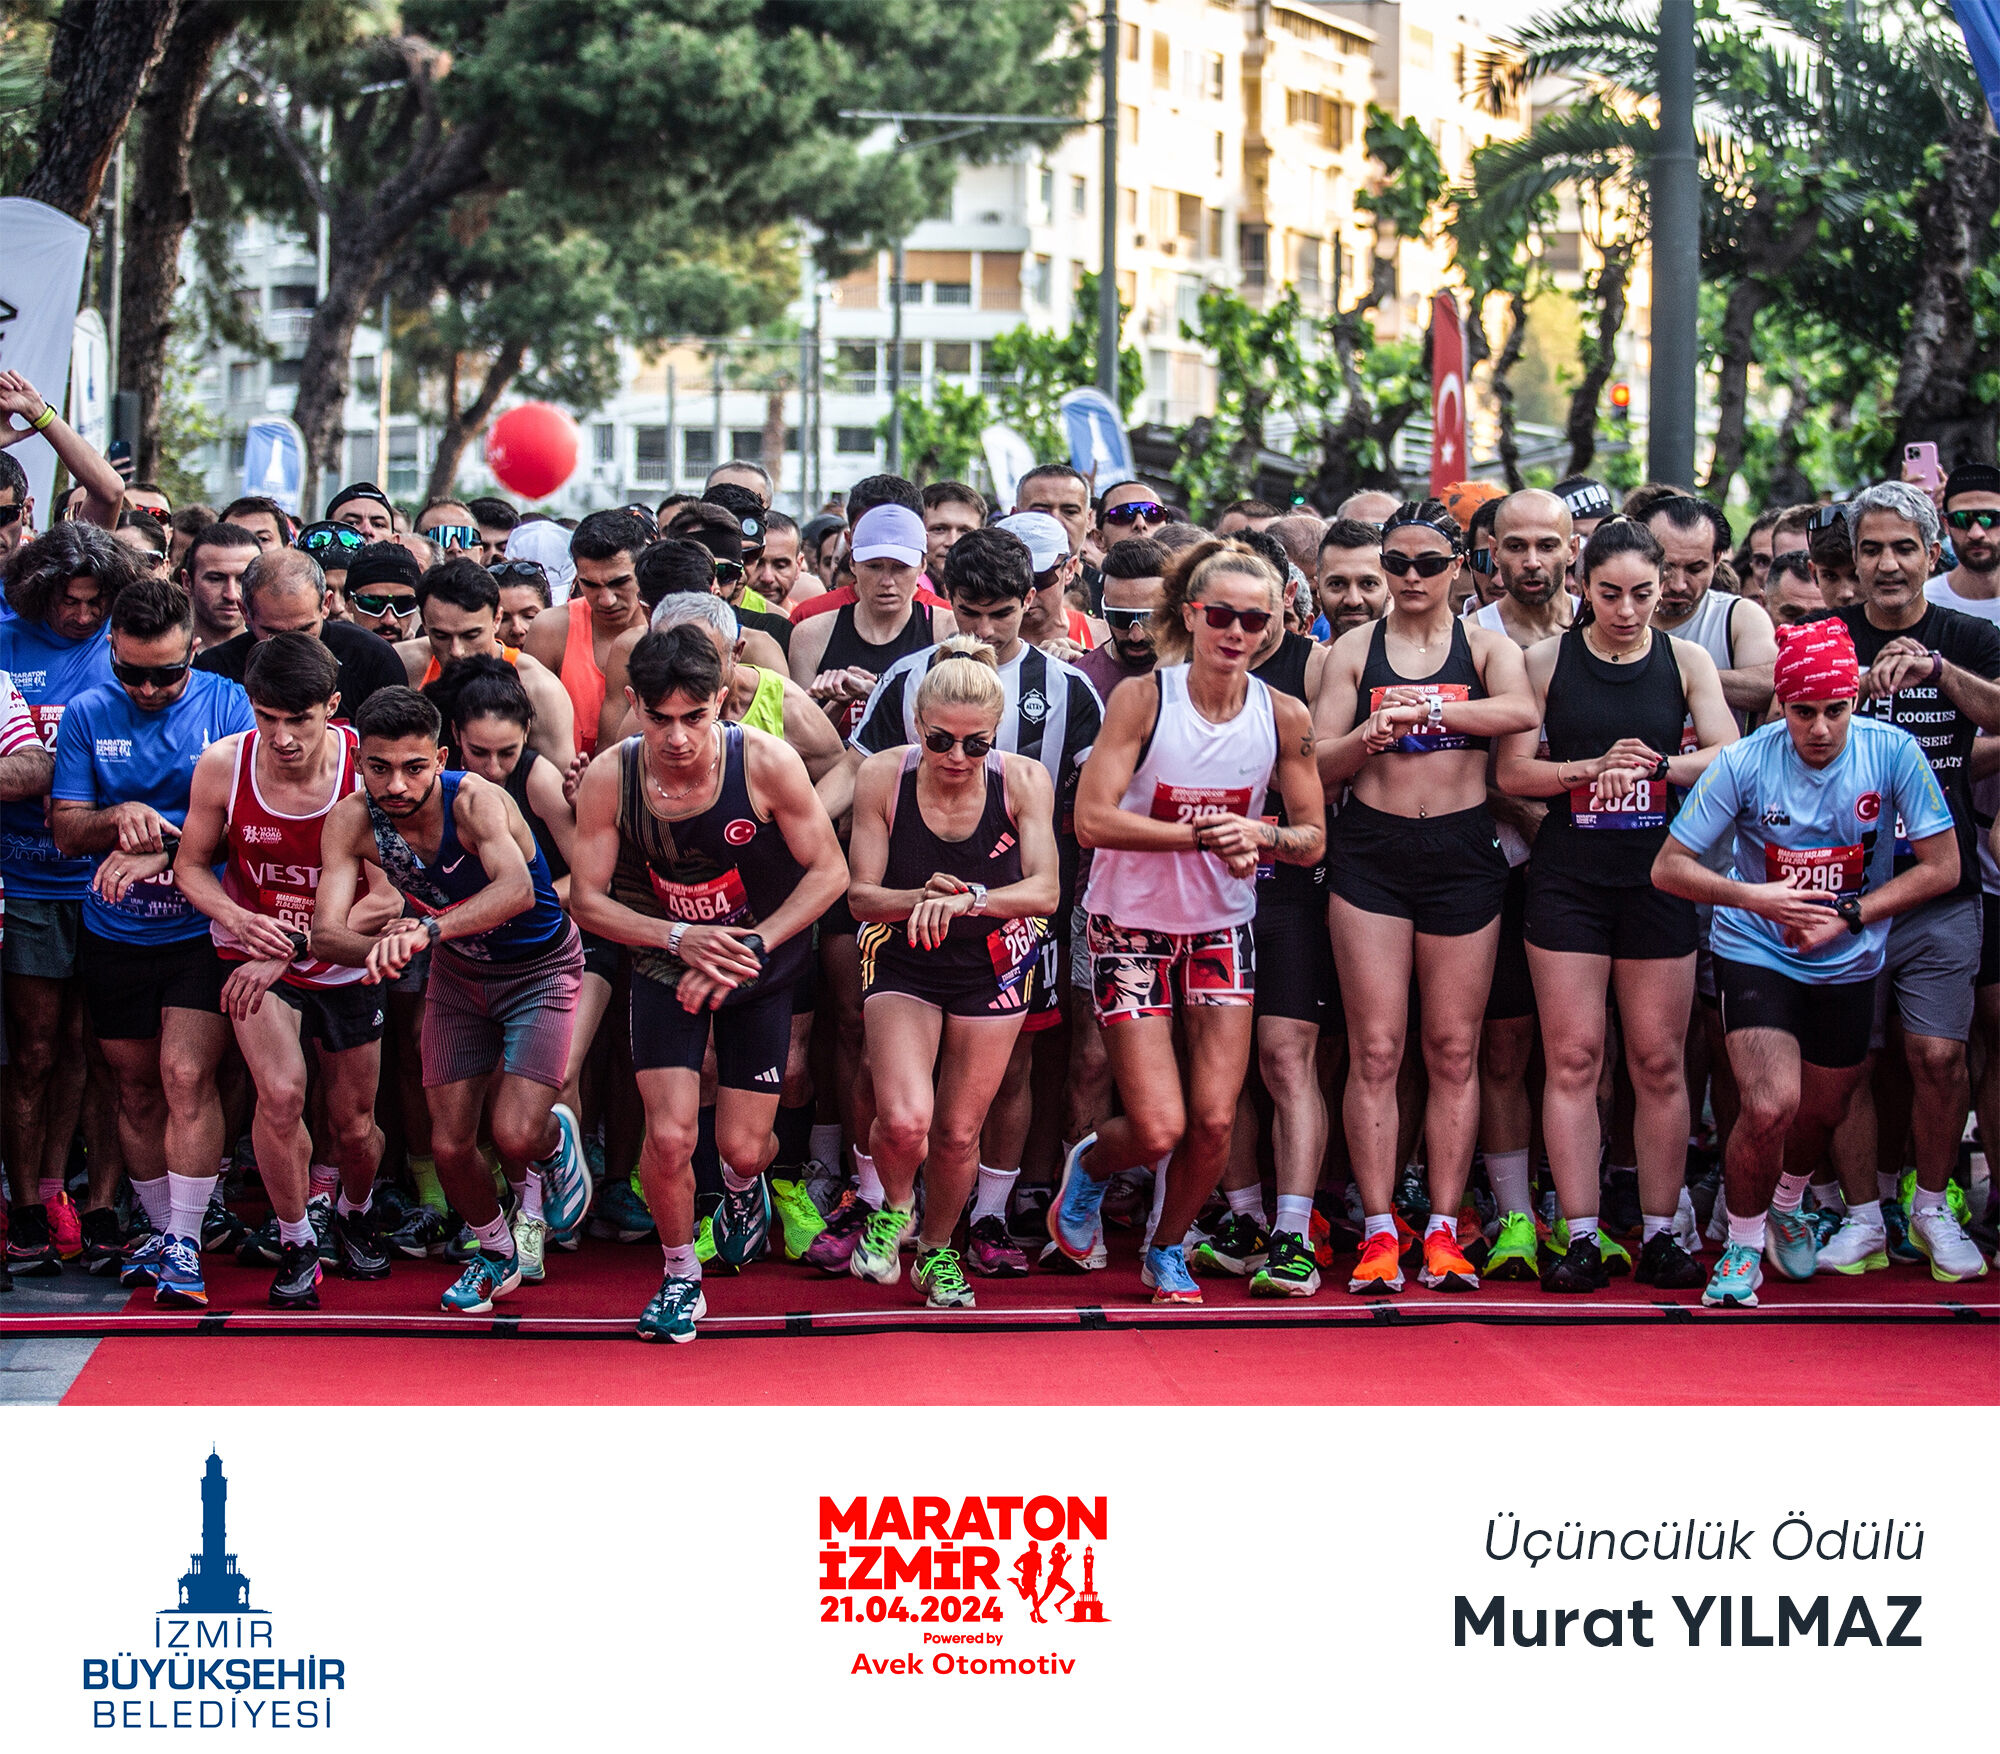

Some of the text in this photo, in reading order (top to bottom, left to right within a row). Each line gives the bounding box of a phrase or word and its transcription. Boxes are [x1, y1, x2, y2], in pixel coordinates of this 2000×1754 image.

[1899, 687, 1938, 699] CAKE
[1896, 711, 1956, 723] COOKIES
[669, 891, 731, 921] 4864
[1041, 940, 1058, 989] 17
